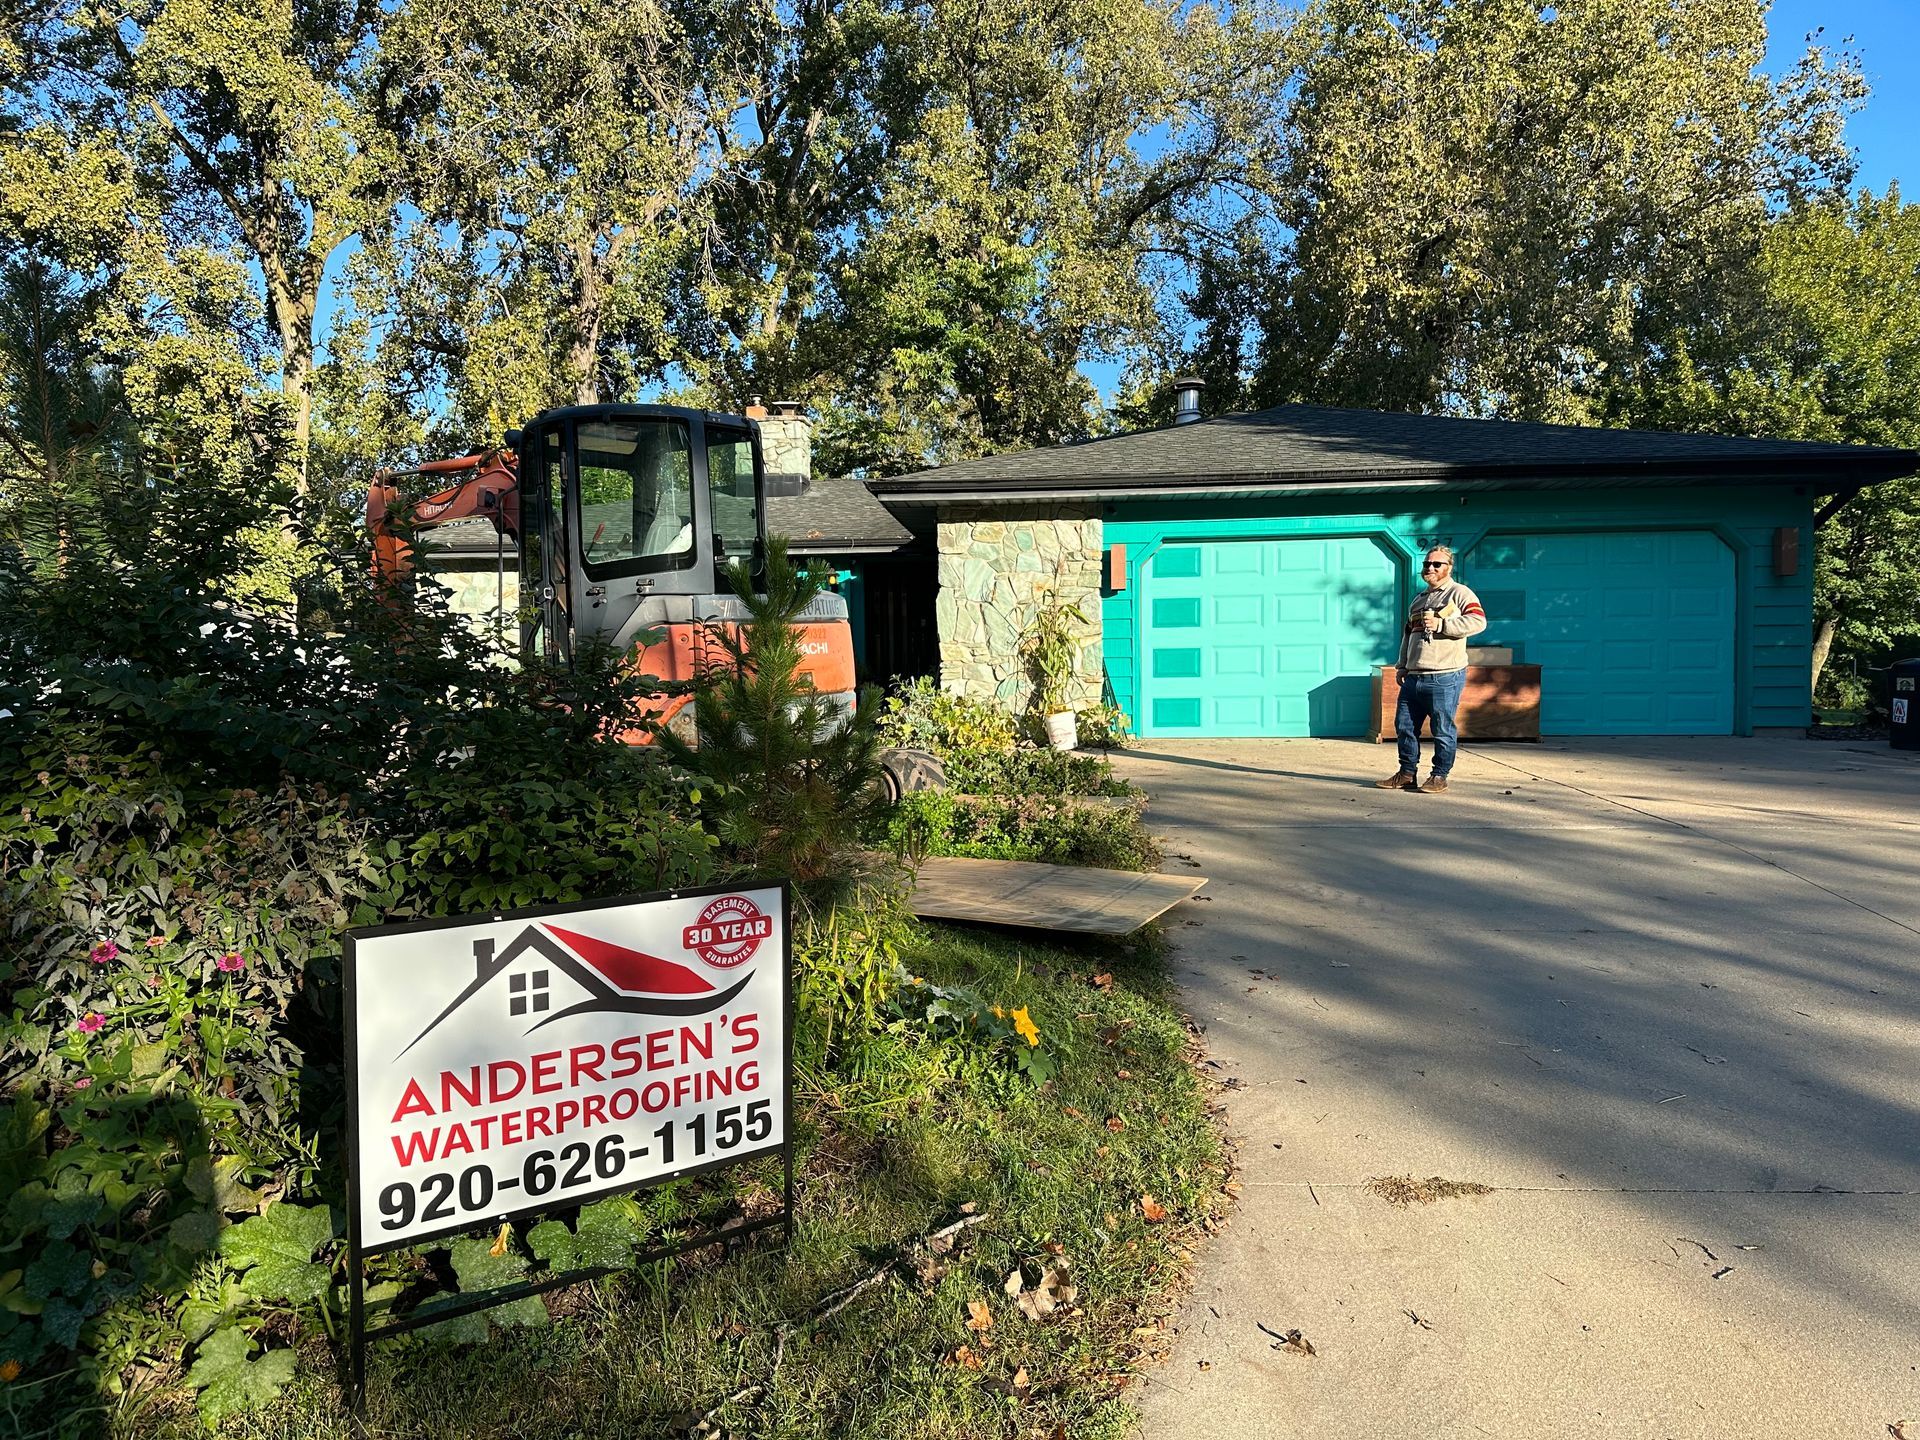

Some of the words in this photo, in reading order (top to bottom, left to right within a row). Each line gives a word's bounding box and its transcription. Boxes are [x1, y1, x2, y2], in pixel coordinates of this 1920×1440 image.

[801, 642, 828, 655] ACHI
[704, 899, 755, 920] BASEMENT
[689, 928, 713, 945] 30
[719, 920, 766, 940] YEAR
[706, 945, 752, 965] GUARANTEE
[391, 1013, 760, 1123] ANDERSEN'S
[391, 1060, 760, 1167] WATERPROOFING
[378, 1098, 772, 1231] 920-626-1155
